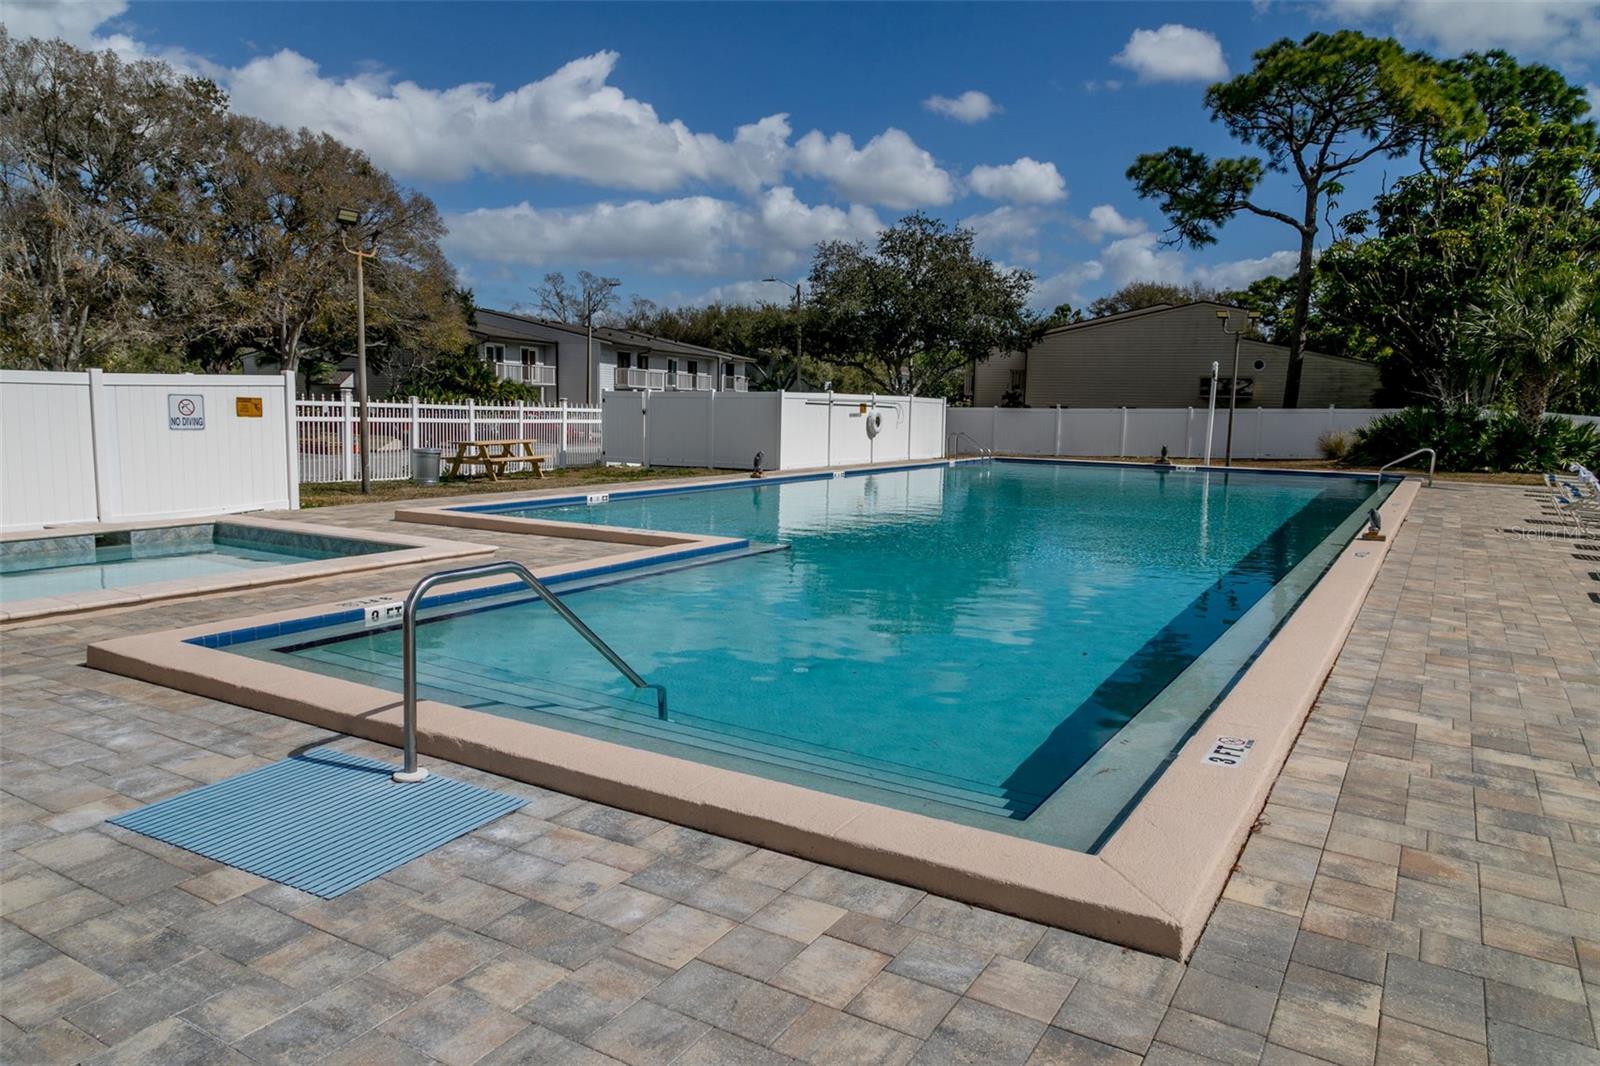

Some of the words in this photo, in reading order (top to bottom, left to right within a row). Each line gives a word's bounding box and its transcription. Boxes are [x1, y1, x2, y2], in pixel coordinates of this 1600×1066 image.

[170, 417, 181, 426] NO
[182, 417, 204, 426] DIVING
[1213, 745, 1244, 758] FT
[1208, 756, 1237, 765] 3
